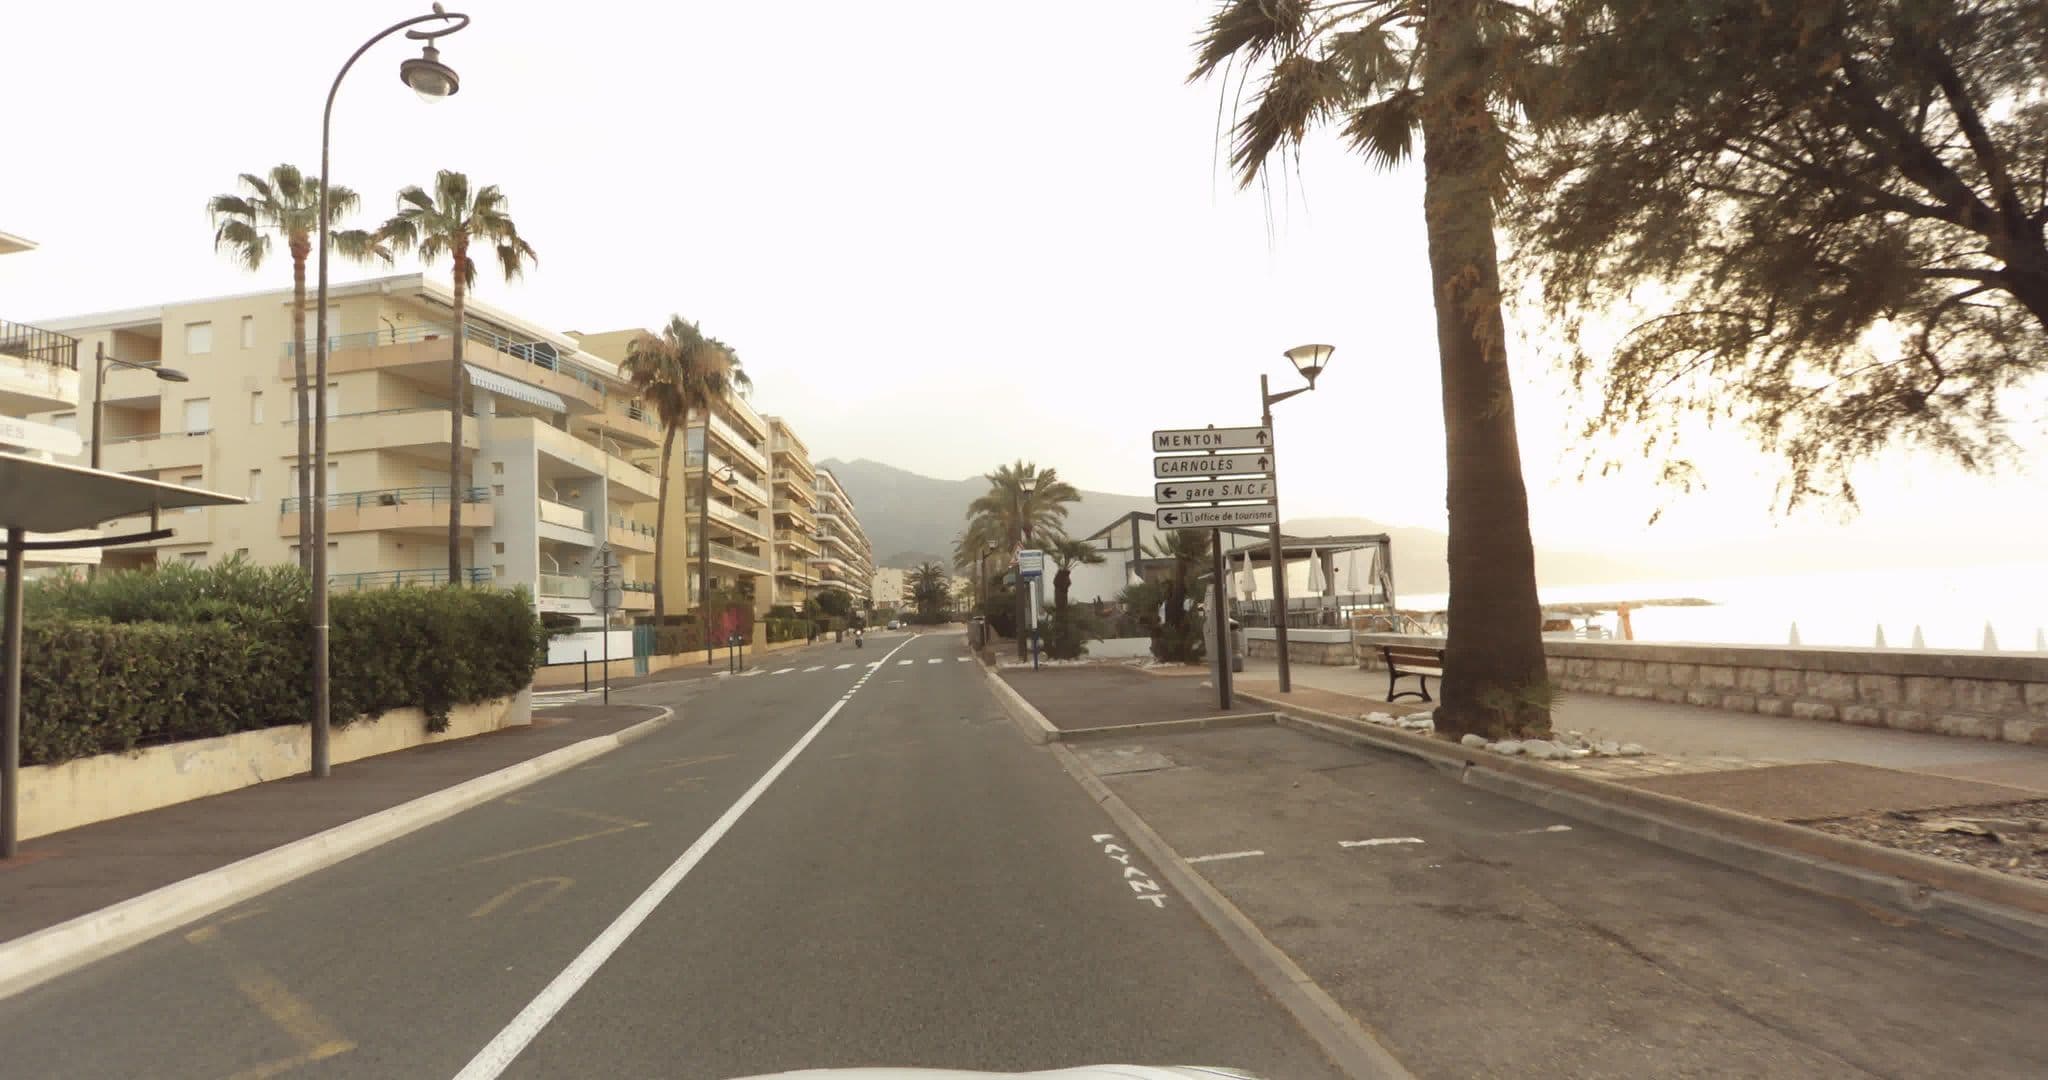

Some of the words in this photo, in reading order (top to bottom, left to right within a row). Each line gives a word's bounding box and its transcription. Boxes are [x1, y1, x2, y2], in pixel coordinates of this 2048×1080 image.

[1159, 434, 1222, 446] MENTON
[1186, 488, 1215, 499] gare
[1195, 511, 1220, 522] office
[1222, 511, 1233, 521] de
[1235, 511, 1273, 521] tourisme
